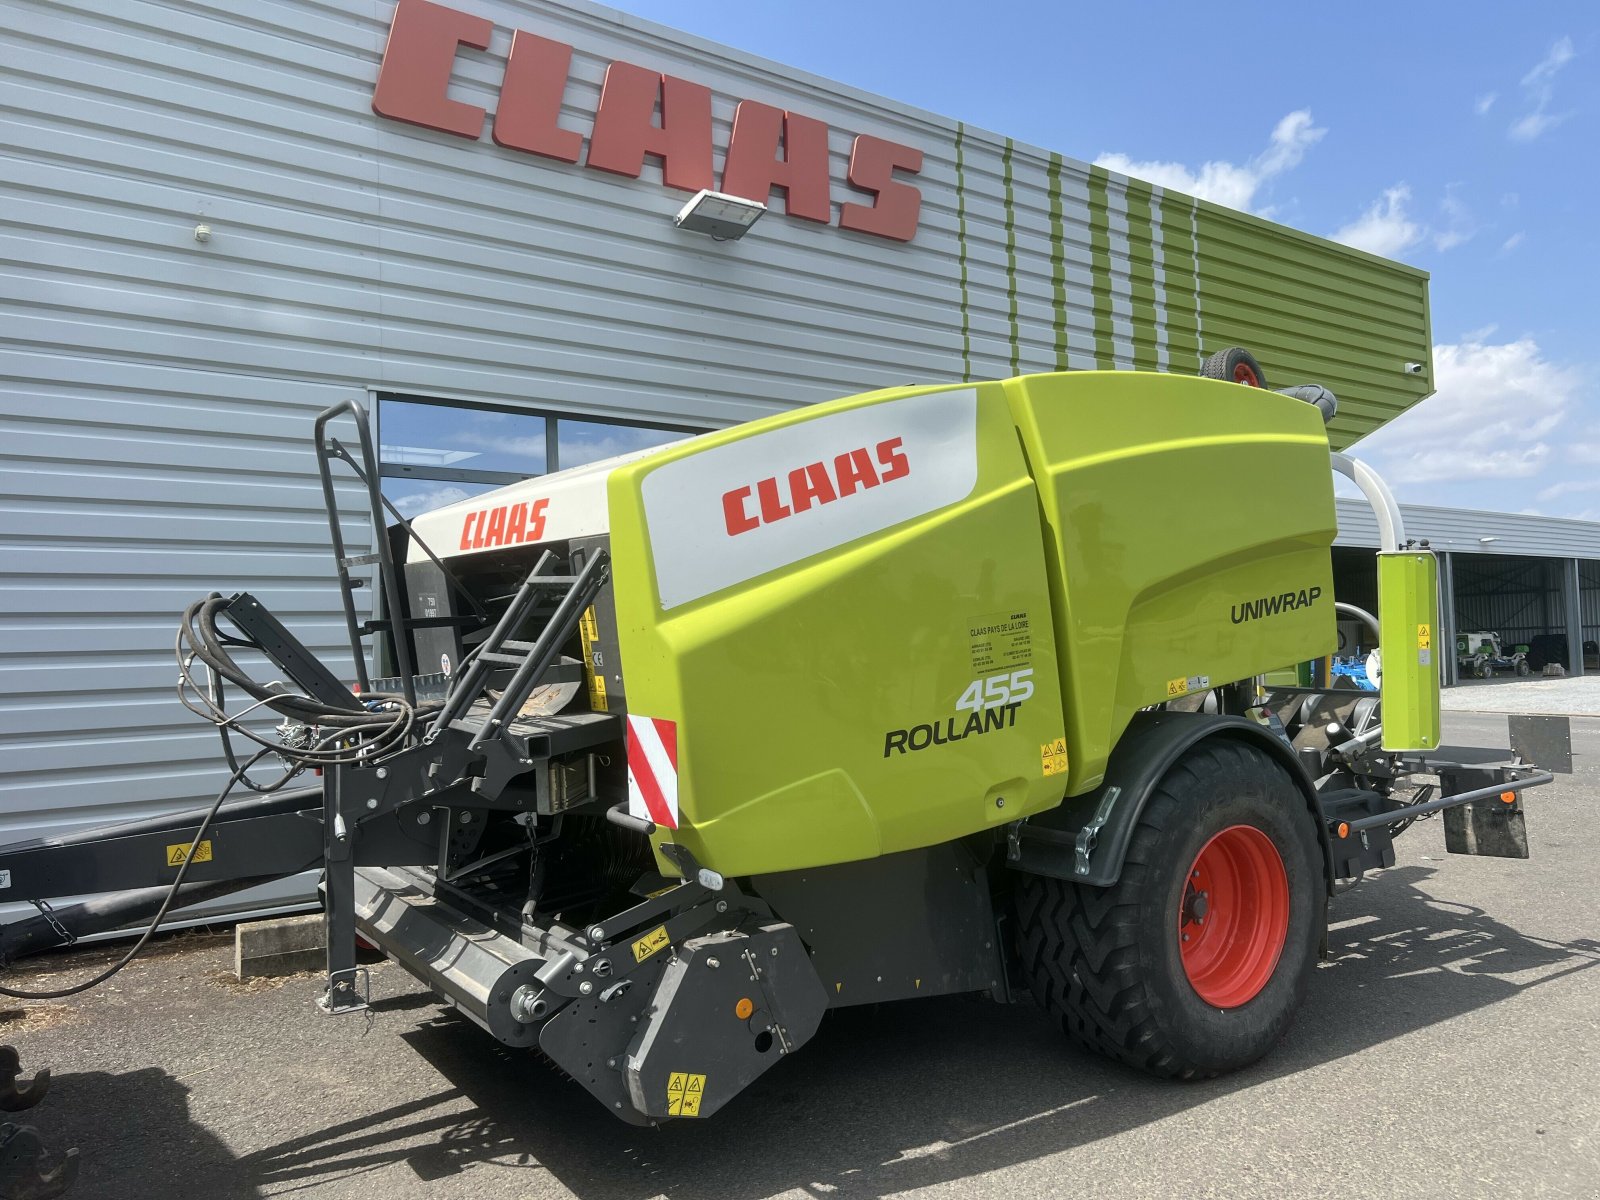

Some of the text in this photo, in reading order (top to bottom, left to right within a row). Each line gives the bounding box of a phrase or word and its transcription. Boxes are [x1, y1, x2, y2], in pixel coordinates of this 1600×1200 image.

[372, 0, 923, 242] CLAAS
[722, 436, 910, 537] CLAAS
[460, 498, 550, 551] CLAAS
[970, 627, 987, 637] CLAAS
[987, 625, 1001, 635] PAYS
[1001, 623, 1008, 632] DE
[1008, 622, 1016, 631] LA
[1015, 620, 1029, 630] LOIRE
[1231, 586, 1321, 625] UNIWRAP
[955, 668, 1034, 713] 455
[884, 701, 1022, 758] ROLLANT
